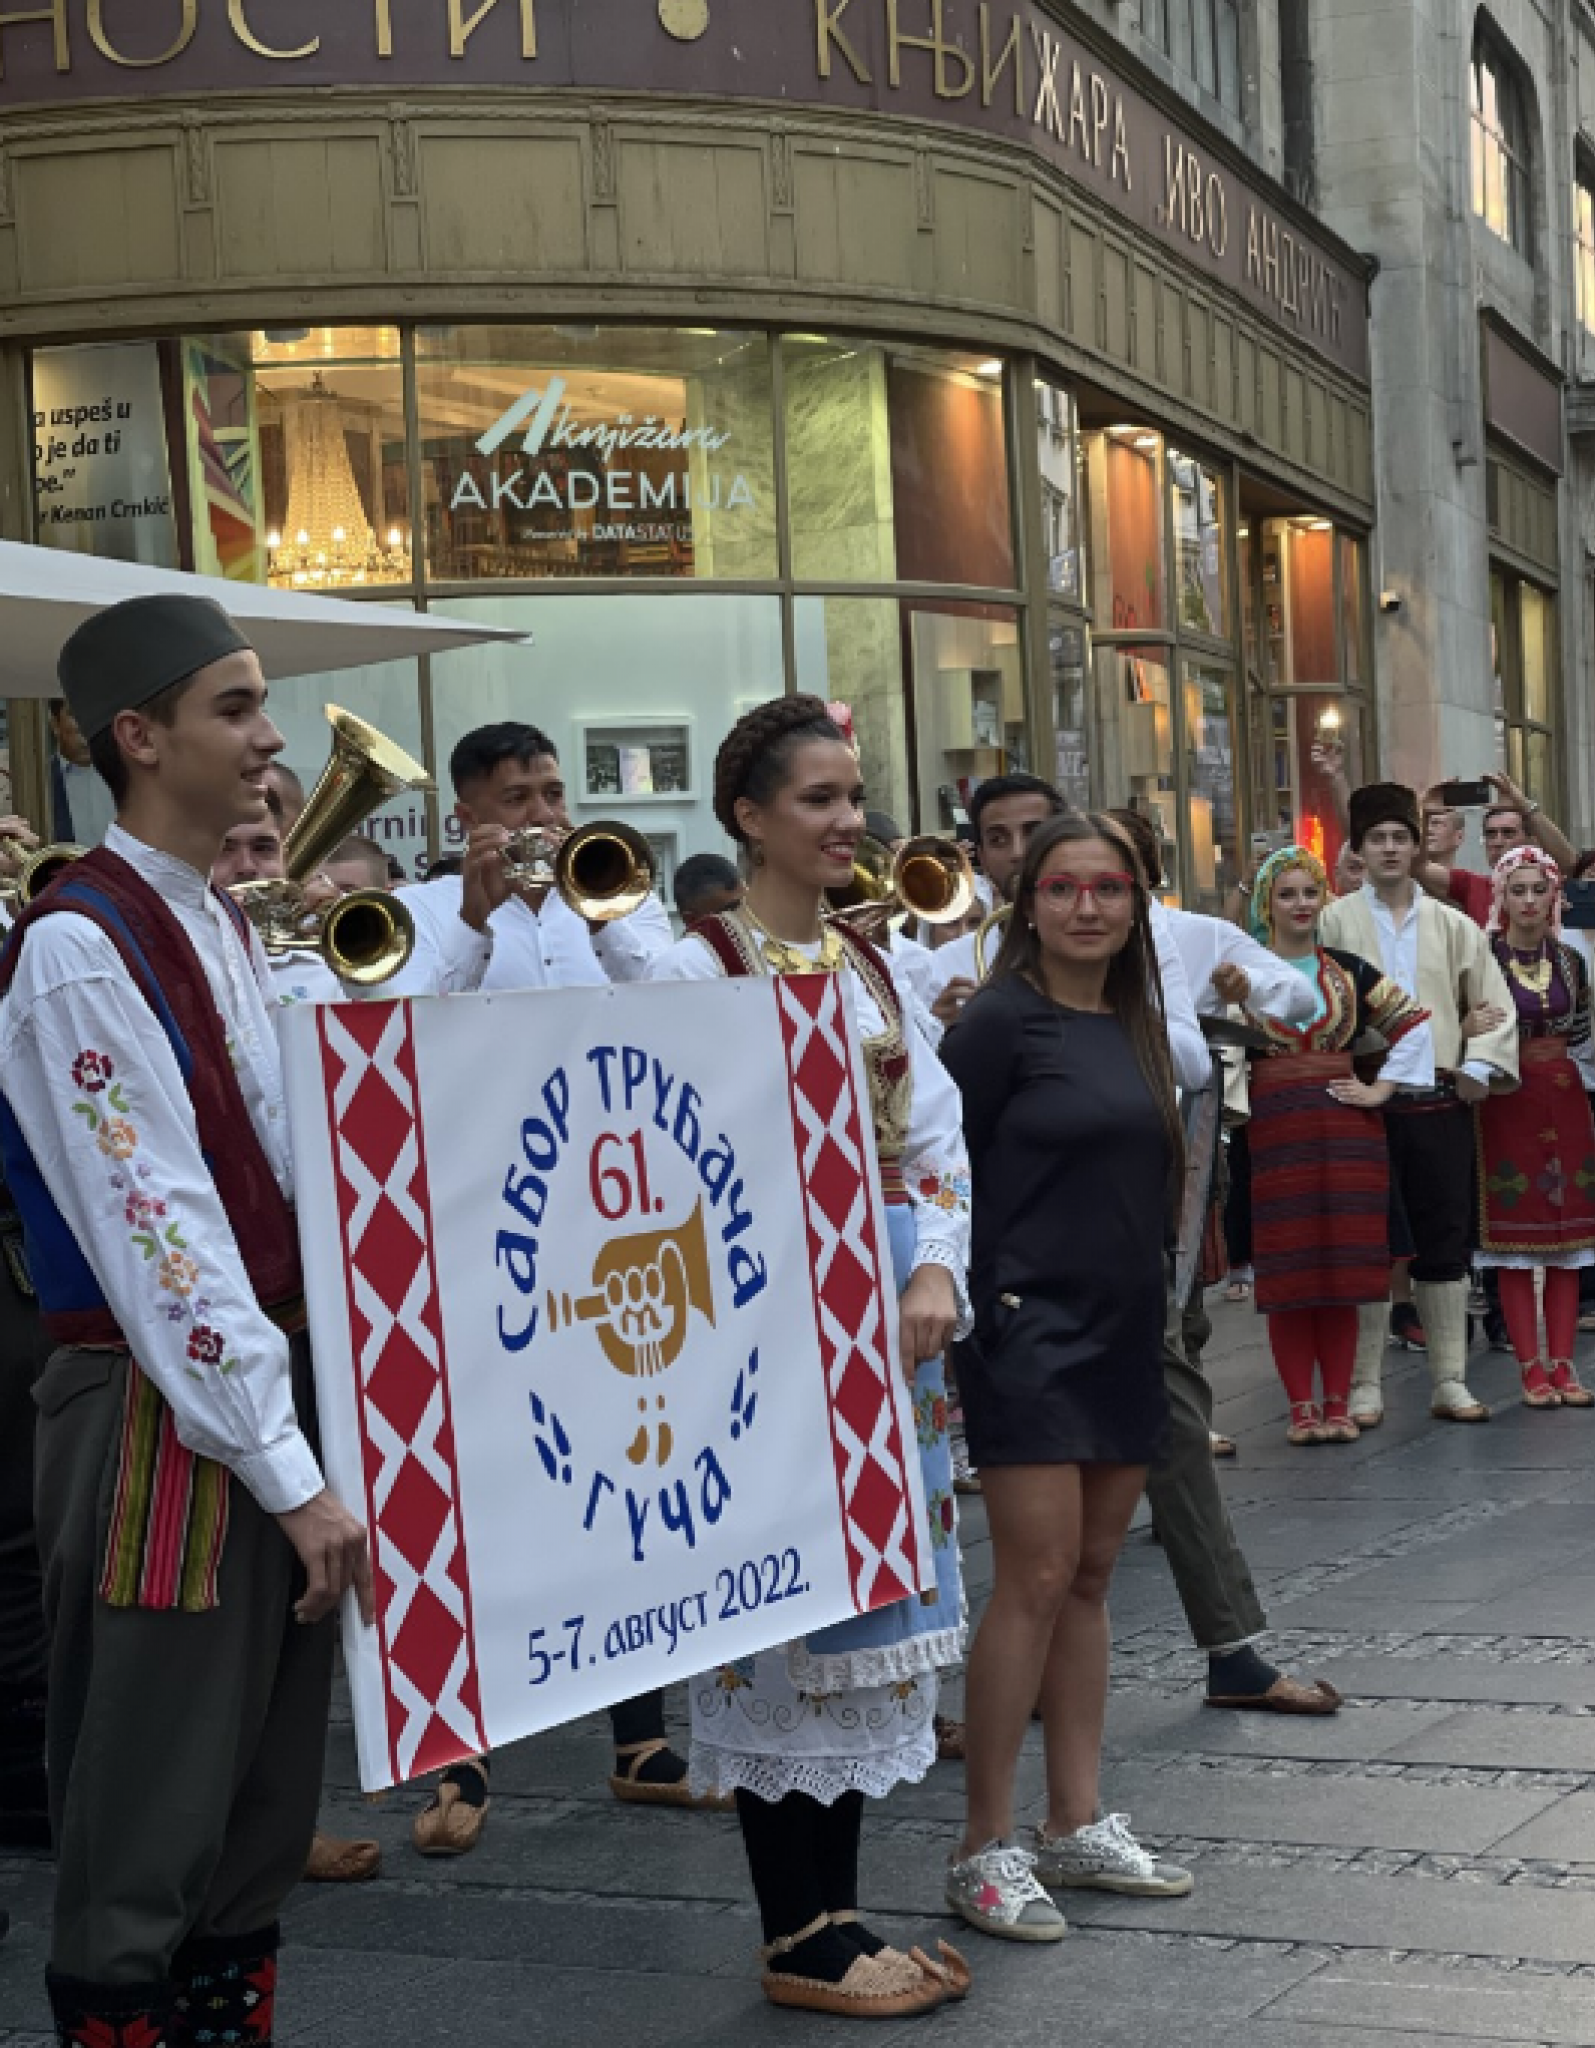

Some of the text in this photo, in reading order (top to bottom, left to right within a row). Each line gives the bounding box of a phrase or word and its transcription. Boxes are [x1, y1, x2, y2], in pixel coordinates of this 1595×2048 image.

[816, 0, 1132, 191] КЊИЖАРА
[51, 397, 111, 430] uspeš
[117, 403, 132, 419] u
[45, 436, 66, 466] je
[72, 433, 99, 457] da
[105, 430, 121, 454] ti
[450, 470, 757, 509] AKADEMIJA
[51, 505, 106, 523] Kenan
[111, 496, 169, 518] Crnkić
[589, 1128, 665, 1221] 61.
[529, 1546, 811, 1685] 5-7. август 2022.
